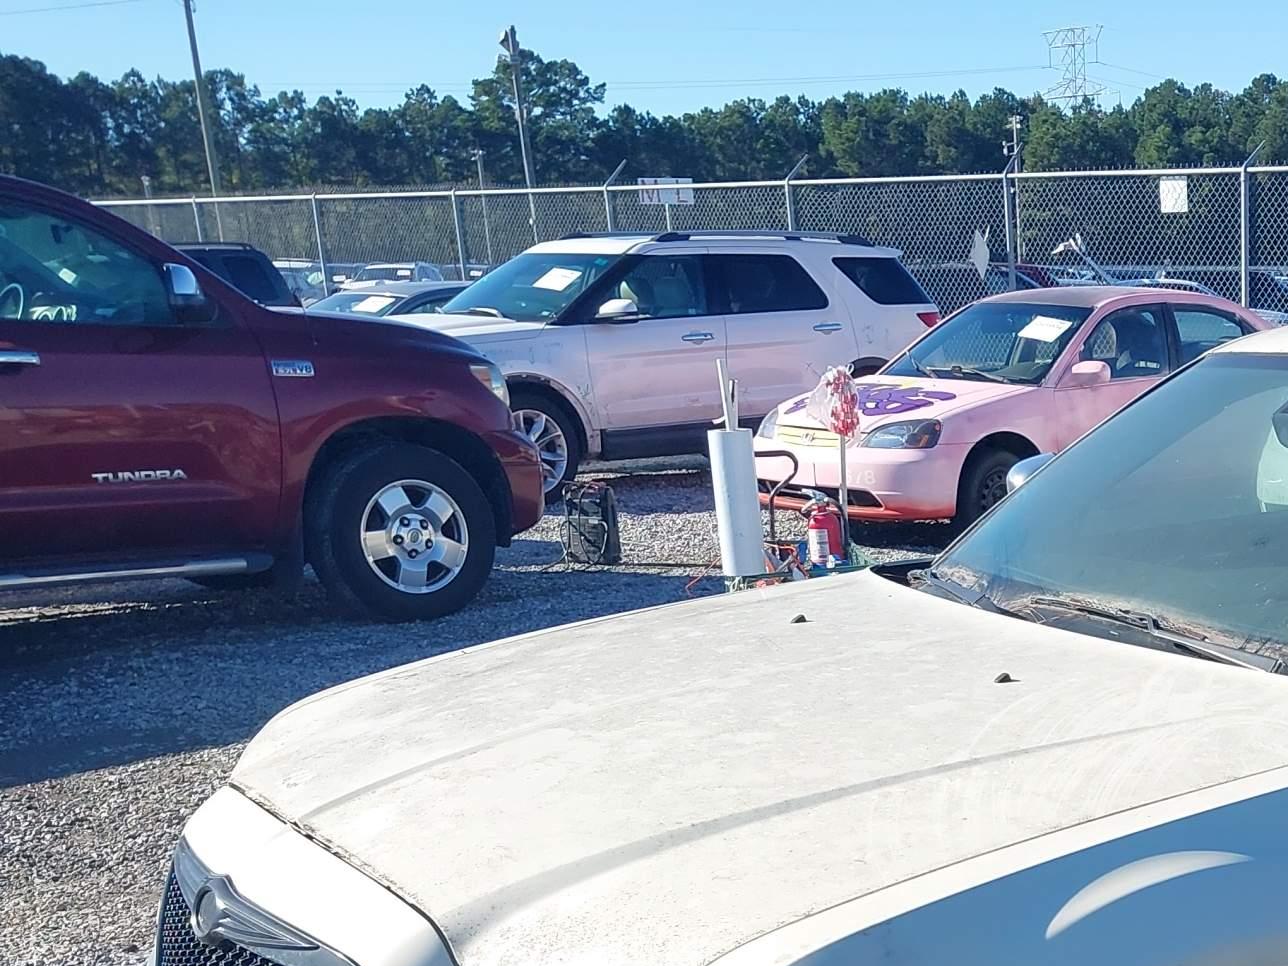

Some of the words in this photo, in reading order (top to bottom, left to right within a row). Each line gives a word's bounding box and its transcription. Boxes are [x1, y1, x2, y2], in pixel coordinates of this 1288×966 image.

[640, 179, 661, 203] M
[676, 179, 689, 203] L
[91, 469, 188, 483] TUNDRA
